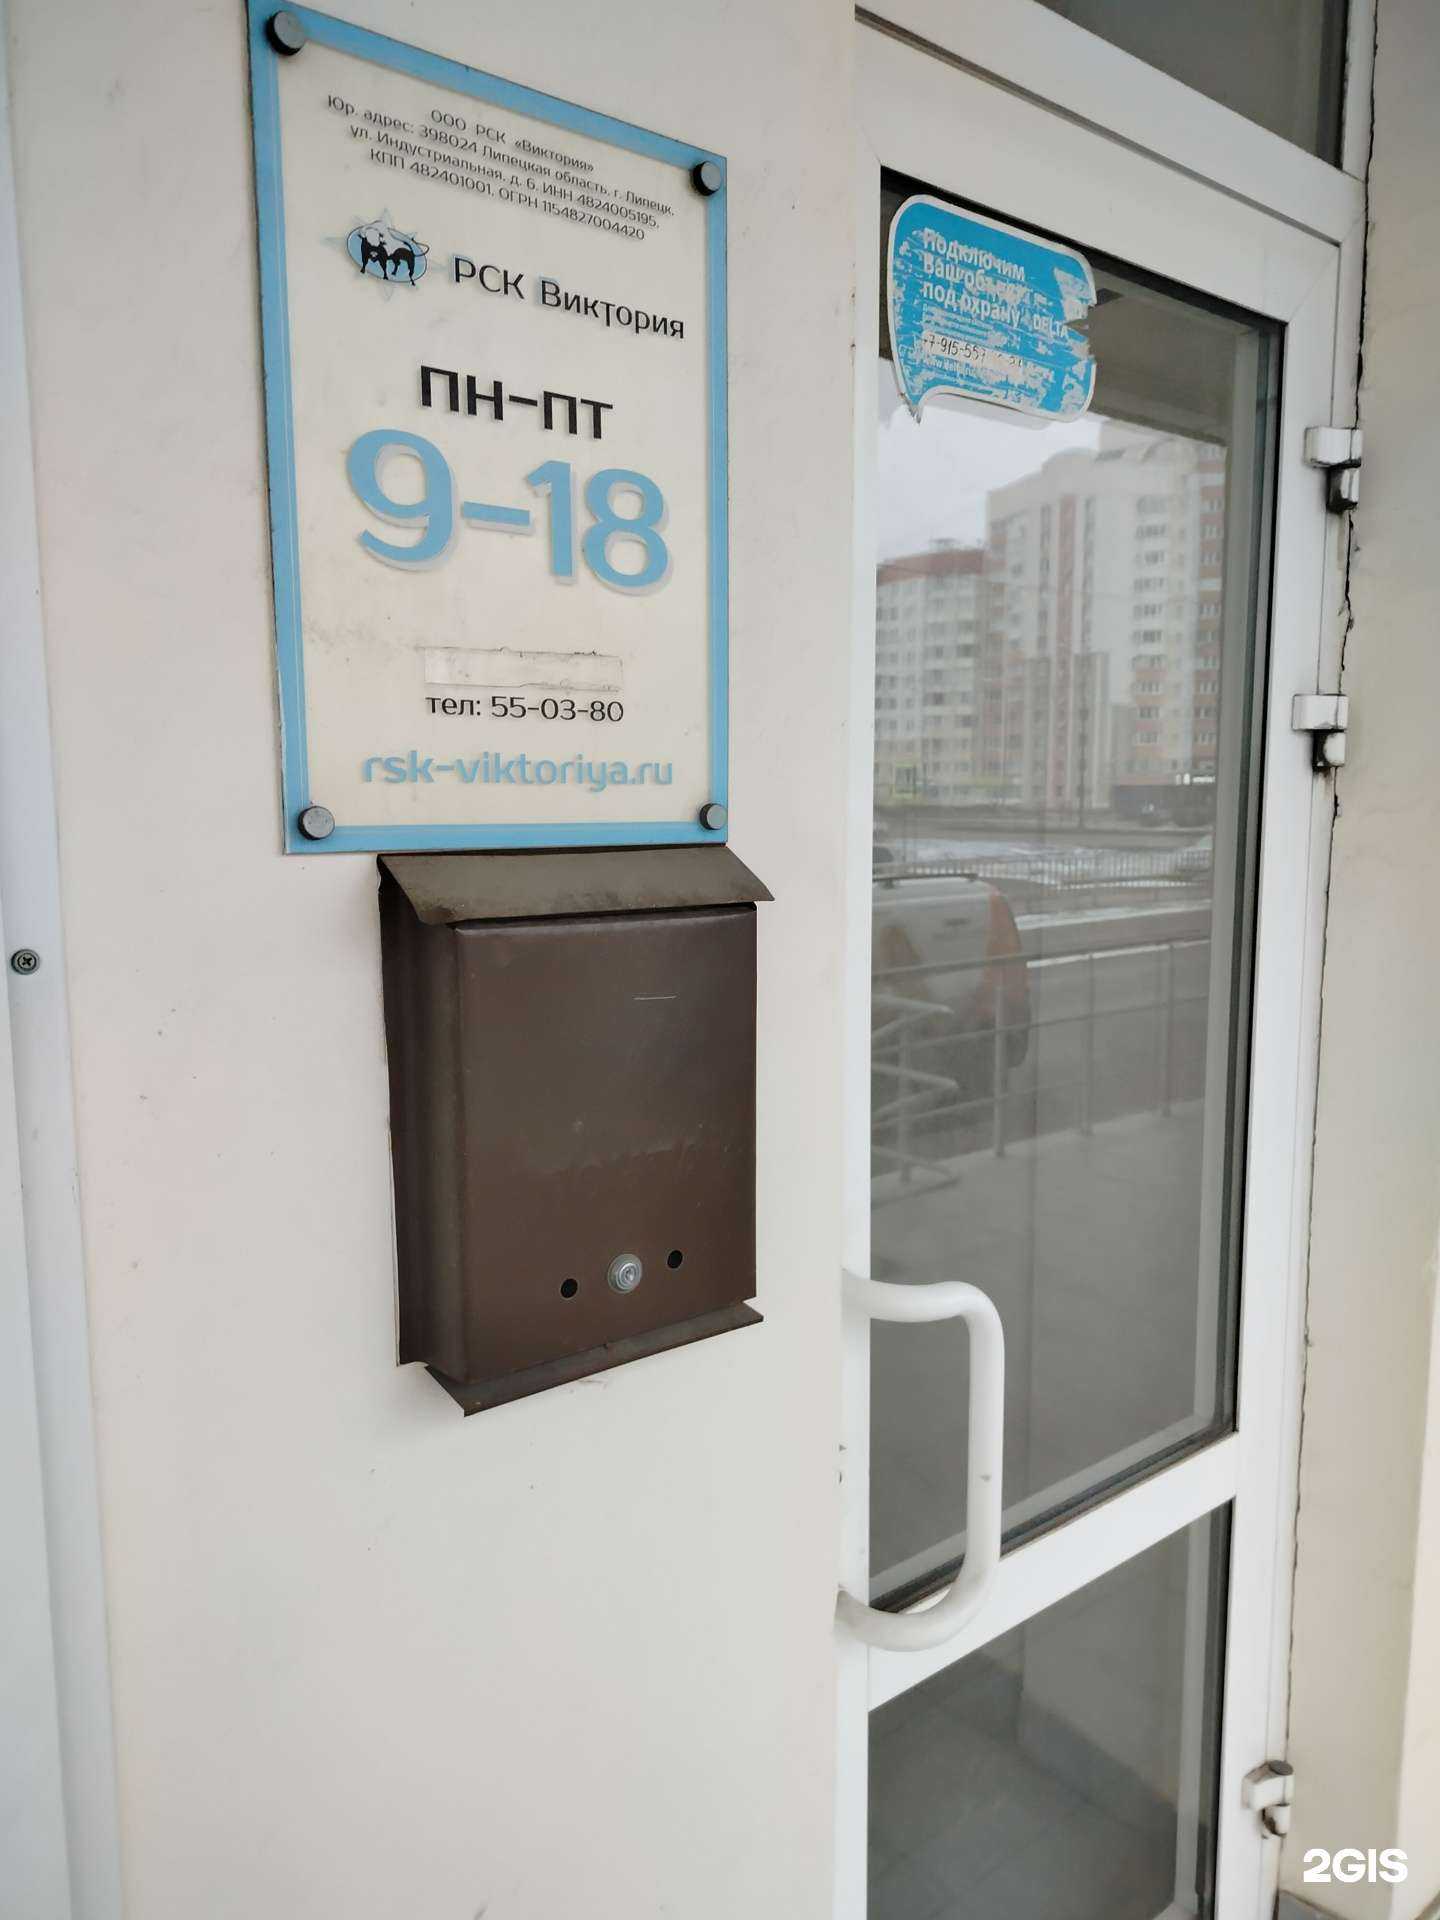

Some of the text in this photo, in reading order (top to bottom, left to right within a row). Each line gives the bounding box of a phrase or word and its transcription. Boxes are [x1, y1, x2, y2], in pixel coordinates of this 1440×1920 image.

[327, 94, 358, 116] Юр.
[363, 109, 414, 134] адрес:
[419, 124, 478, 153] 398024
[482, 145, 551, 177] Липецкая
[613, 189, 622, 200] г.
[350, 124, 373, 141] ул.
[509, 174, 522, 187] д.
[543, 181, 573, 202] ИНН
[430, 109, 595, 172] ООО РСК «Виктория»
[370, 148, 405, 170] КПП
[499, 187, 538, 210] ОГРН
[541, 199, 645, 241] 1154827004420
[922, 227, 1025, 282] Подключим
[453, 256, 686, 340] РСК Виктория
[922, 280, 958, 312] под
[346, 428, 670, 588] 9-18
[424, 695, 625, 722] тел: 55-03-80
[361, 750, 673, 793] rsk-viktoriya.ru
